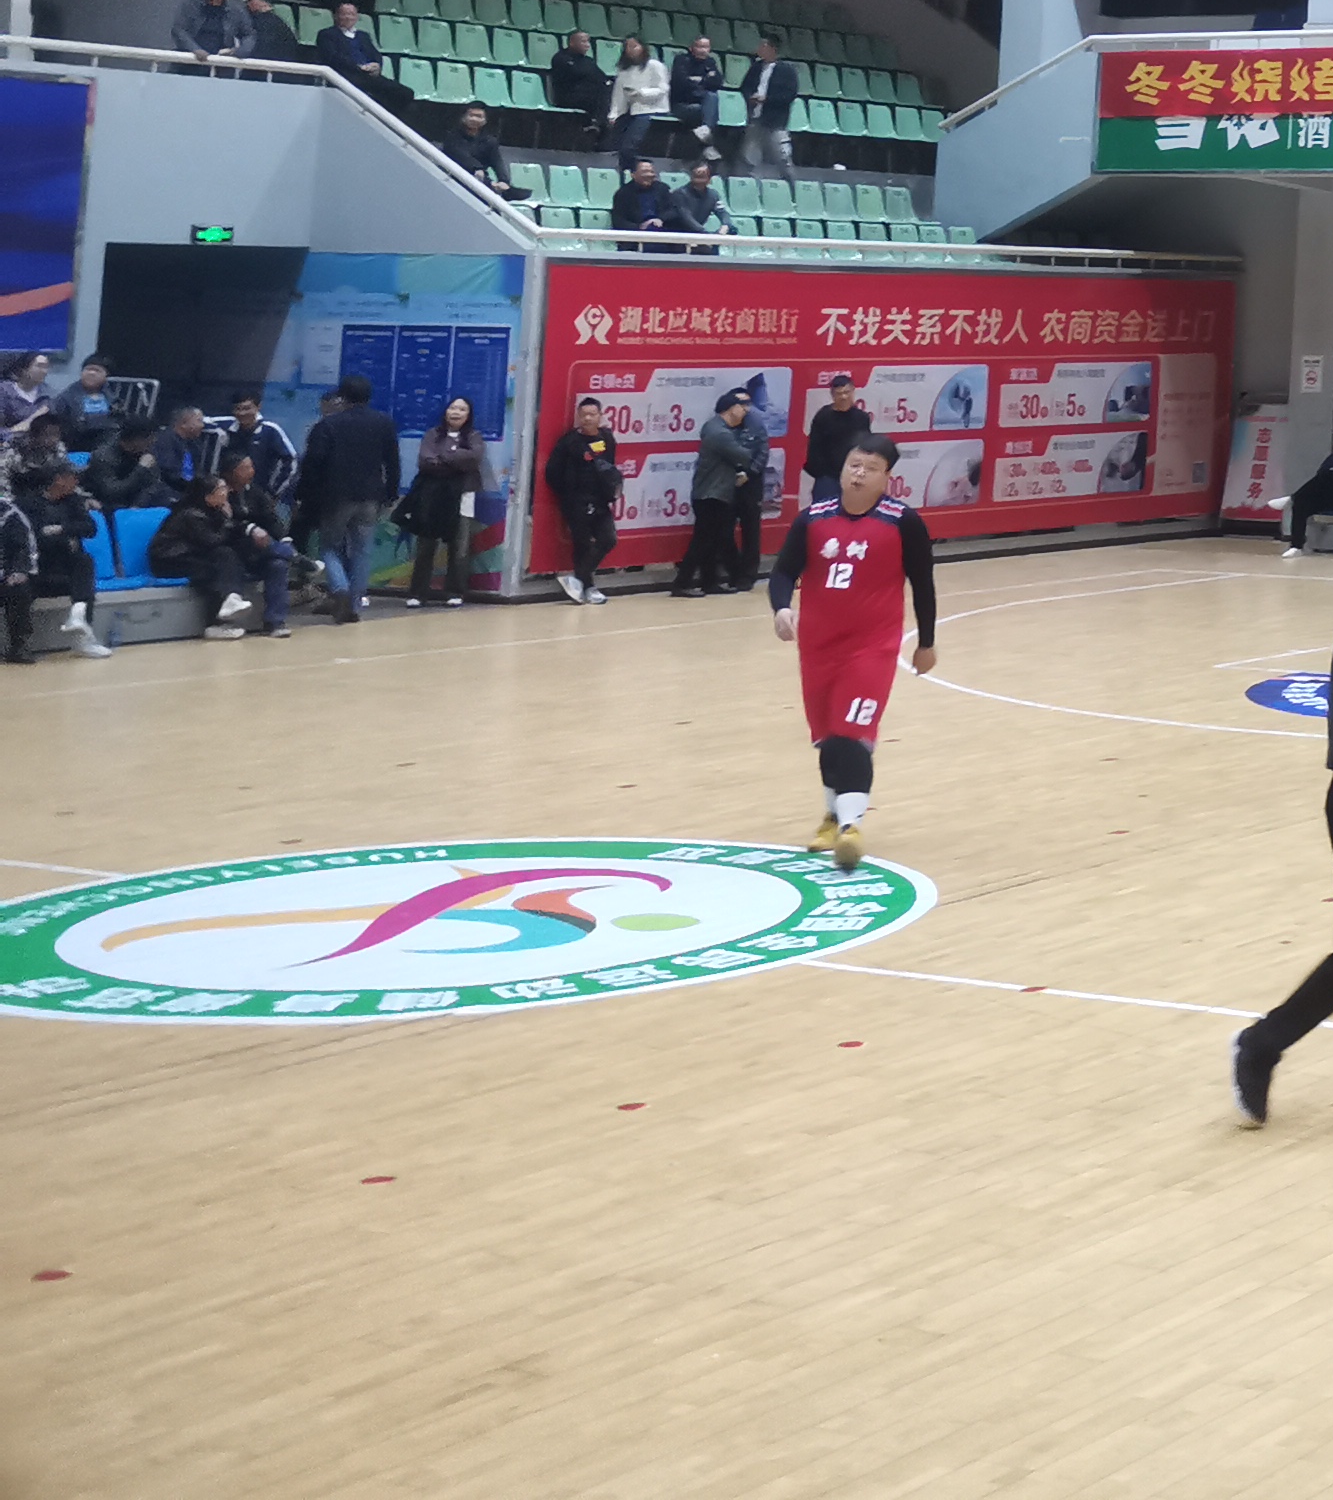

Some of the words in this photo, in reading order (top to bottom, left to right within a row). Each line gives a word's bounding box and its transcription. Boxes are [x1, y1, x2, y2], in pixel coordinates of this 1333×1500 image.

[618, 306, 799, 334] 湖北应城农商银行
[816, 306, 1030, 346] 不找关系不找人
[1039, 308, 1215, 345] 农商资金送上门
[824, 562, 854, 589] 12
[845, 697, 877, 726] 12
